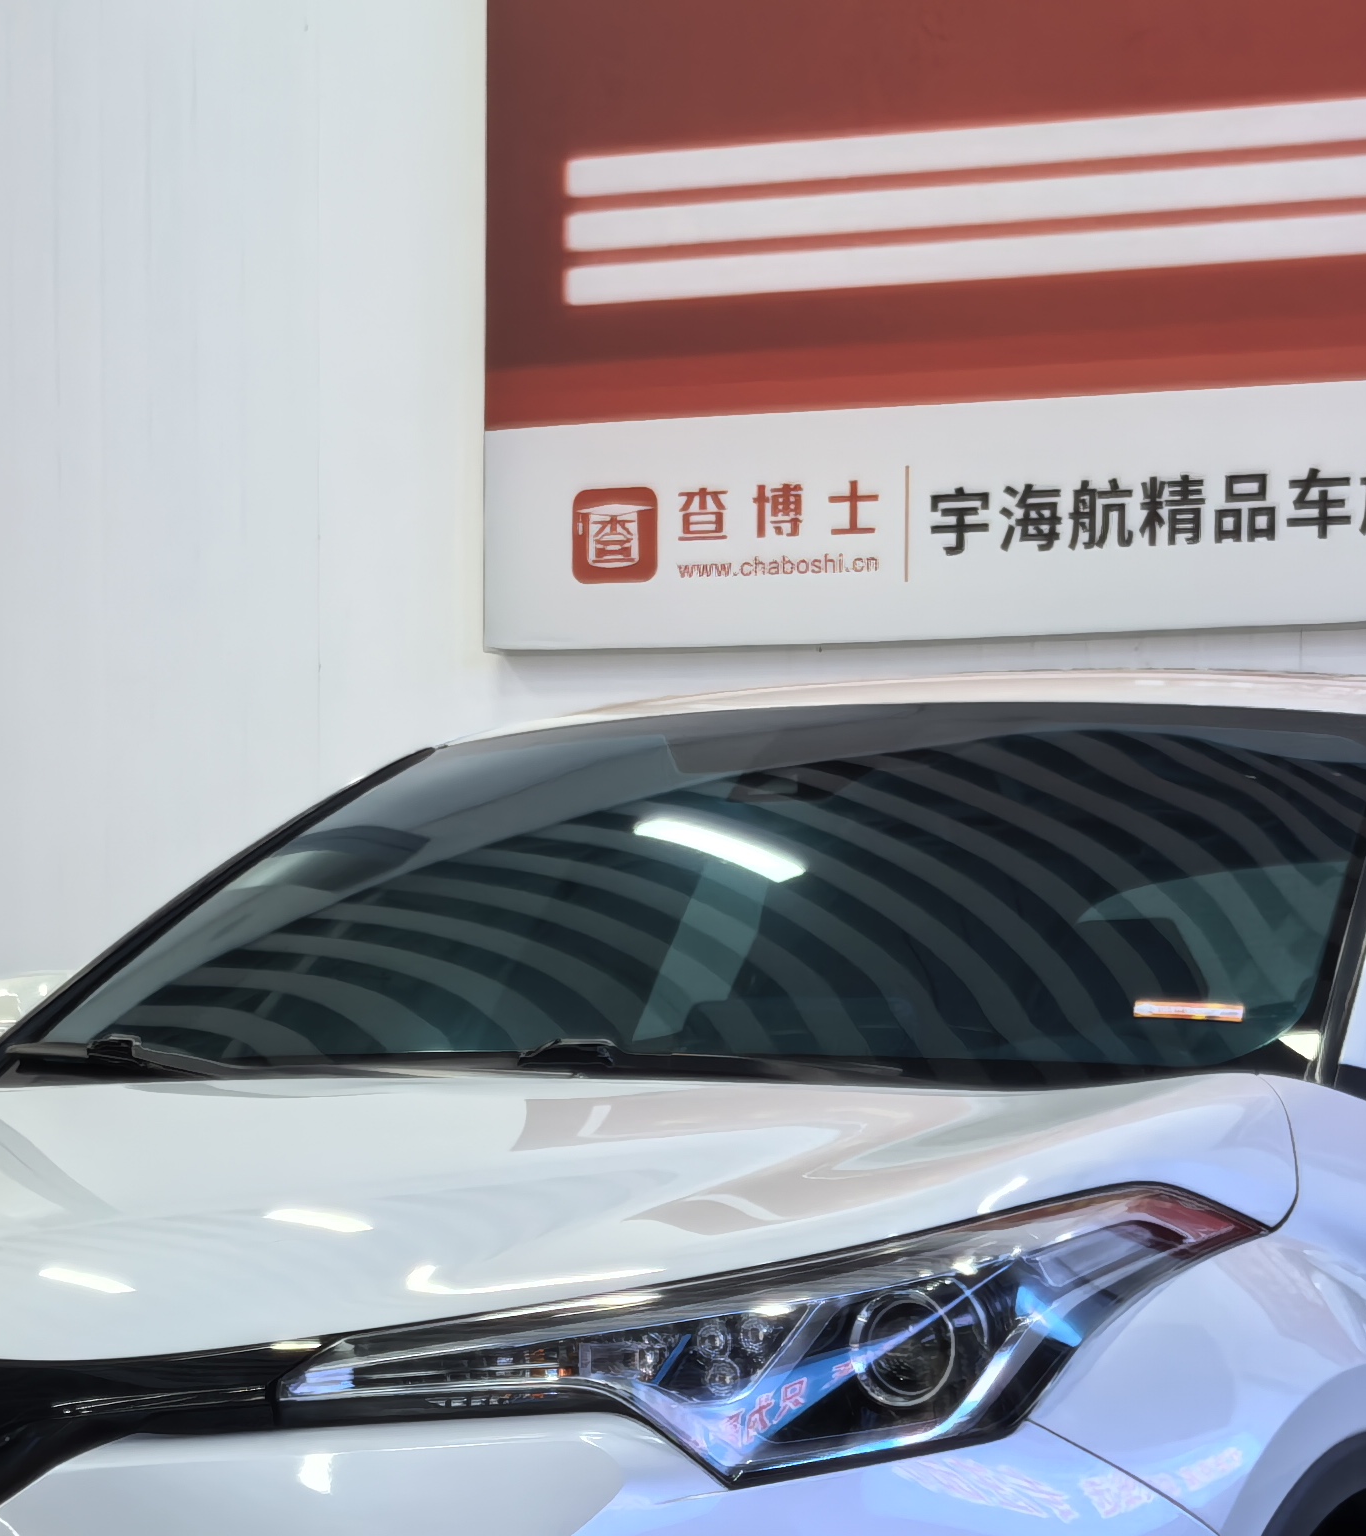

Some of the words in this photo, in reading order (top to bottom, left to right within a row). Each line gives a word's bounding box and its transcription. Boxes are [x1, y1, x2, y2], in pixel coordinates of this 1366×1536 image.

[677, 479, 880, 542] 查博士
[676, 553, 880, 578] www.chaboshi.cn
